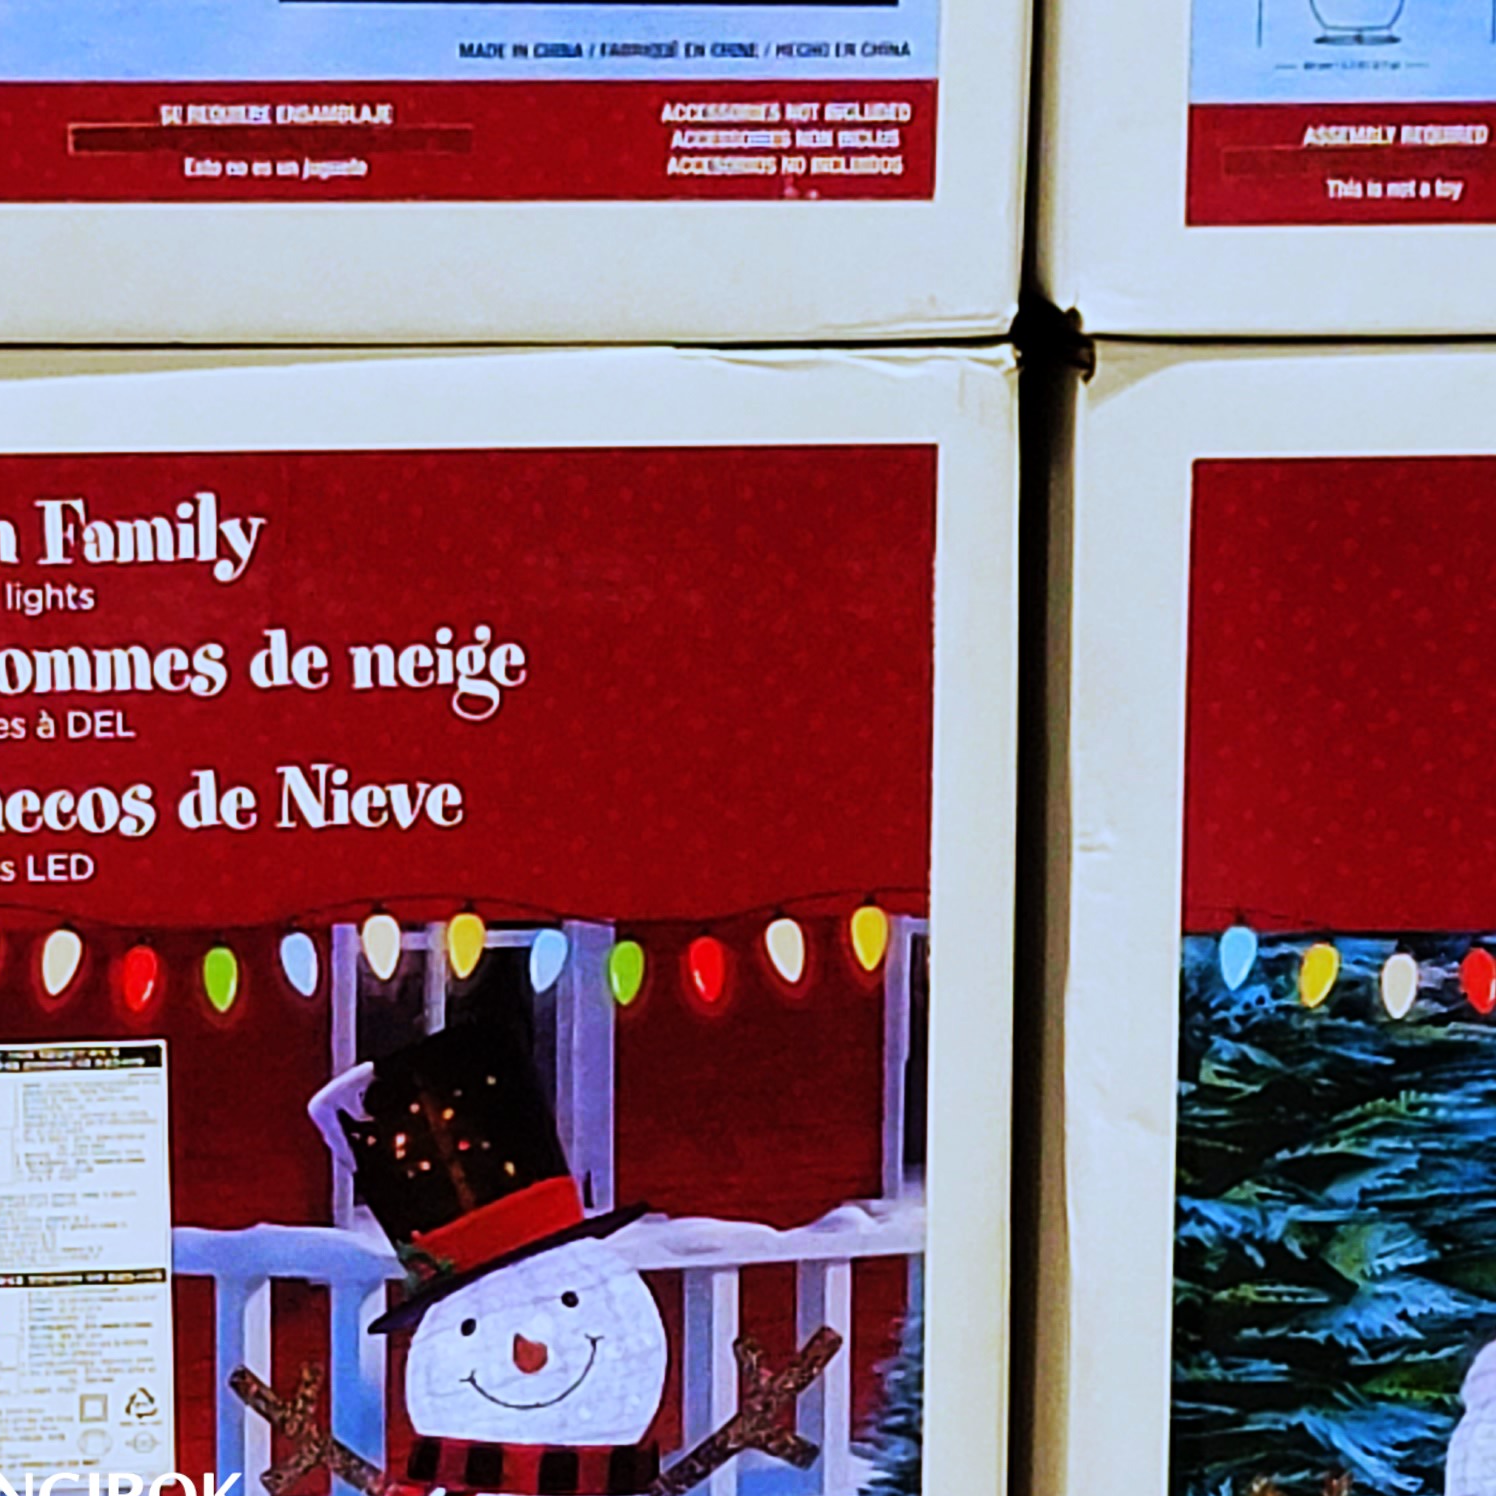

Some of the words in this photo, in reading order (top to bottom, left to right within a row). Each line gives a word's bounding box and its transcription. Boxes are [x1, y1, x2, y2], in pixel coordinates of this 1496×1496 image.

[1303, 125, 1396, 146] ASSEMBLY
[1401, 125, 1488, 144] REQUIRED
[1326, 178, 1362, 198] This
[1367, 178, 1381, 197] is
[1386, 178, 1415, 197] not
[1419, 184, 1431, 197] a
[1434, 178, 1464, 201] toy
[34, 492, 266, 583] Family
[6, 581, 95, 618] lights
[249, 627, 330, 692] de
[350, 625, 526, 720] neige
[35, 711, 56, 740] à
[66, 711, 135, 740] DEL
[177, 769, 256, 832] de
[276, 765, 464, 829] Nieve
[26, 854, 94, 883] LED
